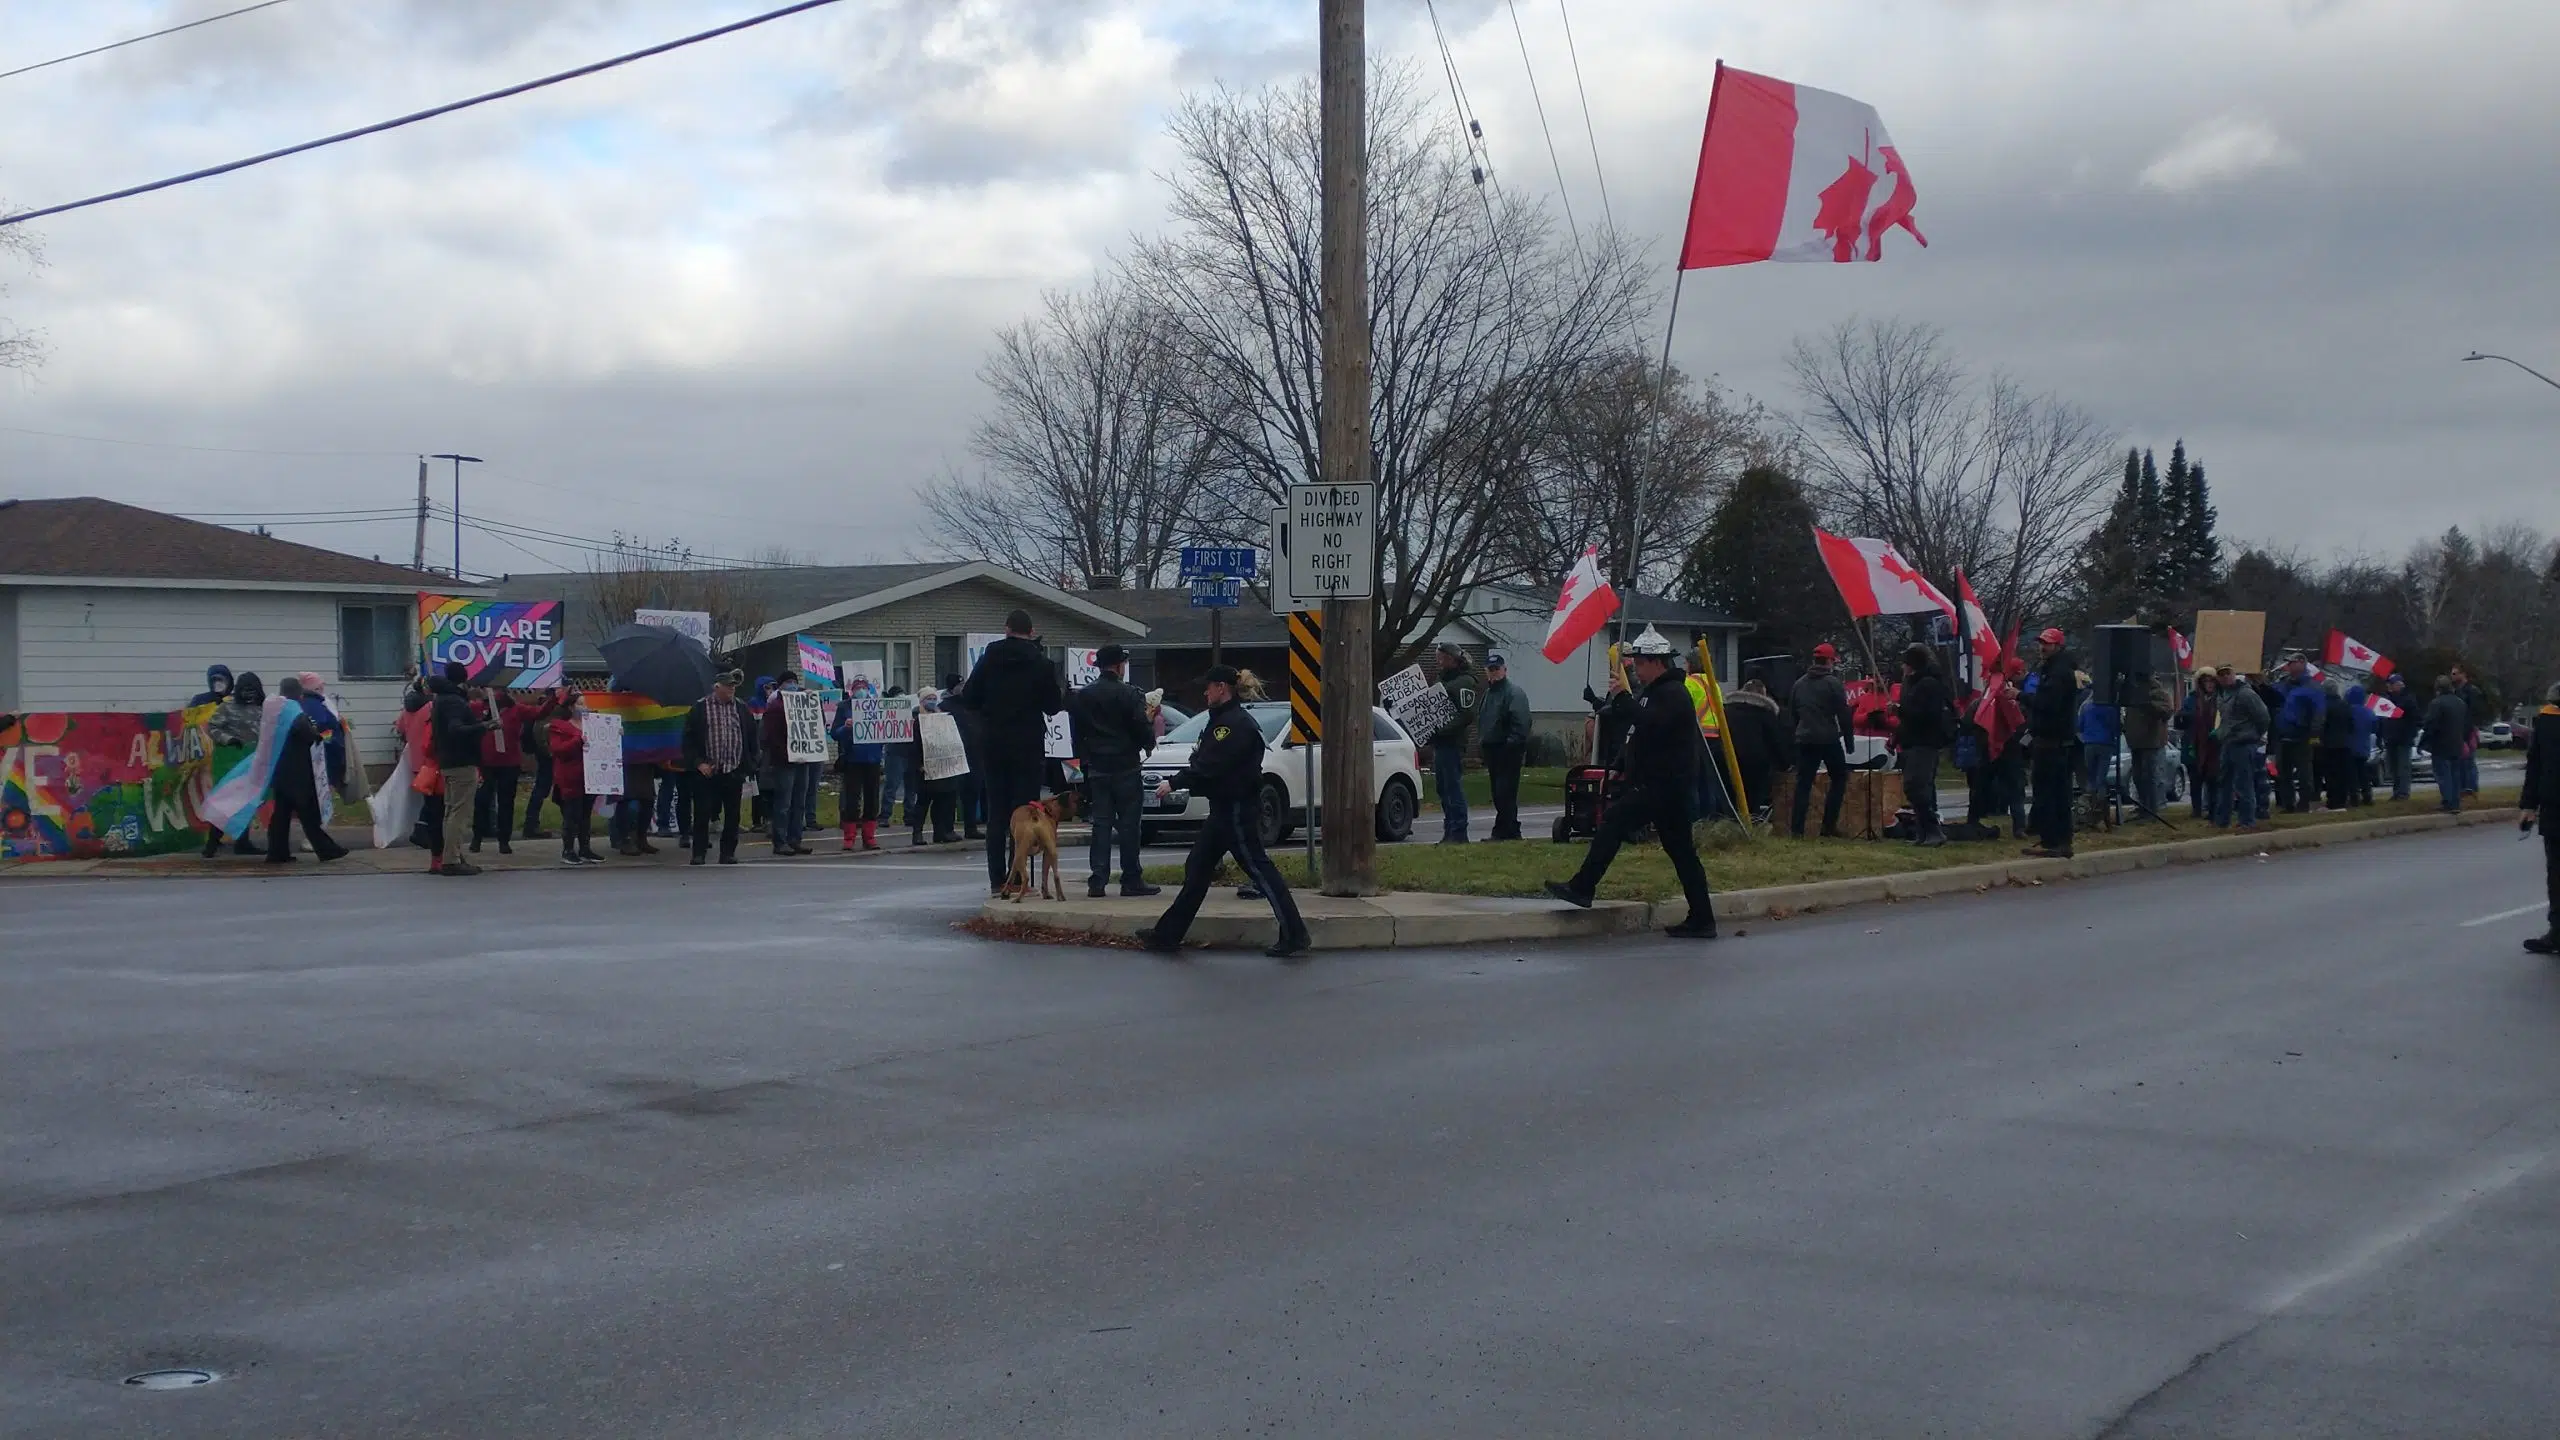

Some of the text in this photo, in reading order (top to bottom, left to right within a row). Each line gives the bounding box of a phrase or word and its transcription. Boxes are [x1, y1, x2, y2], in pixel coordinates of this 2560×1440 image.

[1304, 491, 1360, 506] DIVIDED
[1300, 512, 1363, 527] HIGHWAY
[1323, 533, 1342, 548] NO
[1194, 550, 1242, 566] FIRST ST
[1311, 554, 1352, 569] RIGHT
[1192, 581, 1240, 597] BARNET BLVD
[1314, 575, 1350, 590] TURN
[430, 612, 552, 641] YOU ARE
[431, 637, 551, 669] LOVED
[782, 693, 819, 709] TRANS
[854, 700, 861, 711] A
[861, 700, 877, 711] GAY
[1414, 691, 1449, 714] MEDIA
[787, 709, 819, 721] GIRLS
[886, 710, 897, 719] AN
[790, 721, 820, 740] ARE
[854, 720, 914, 740] OXYMORON
[790, 740, 825, 754] GIRLS
